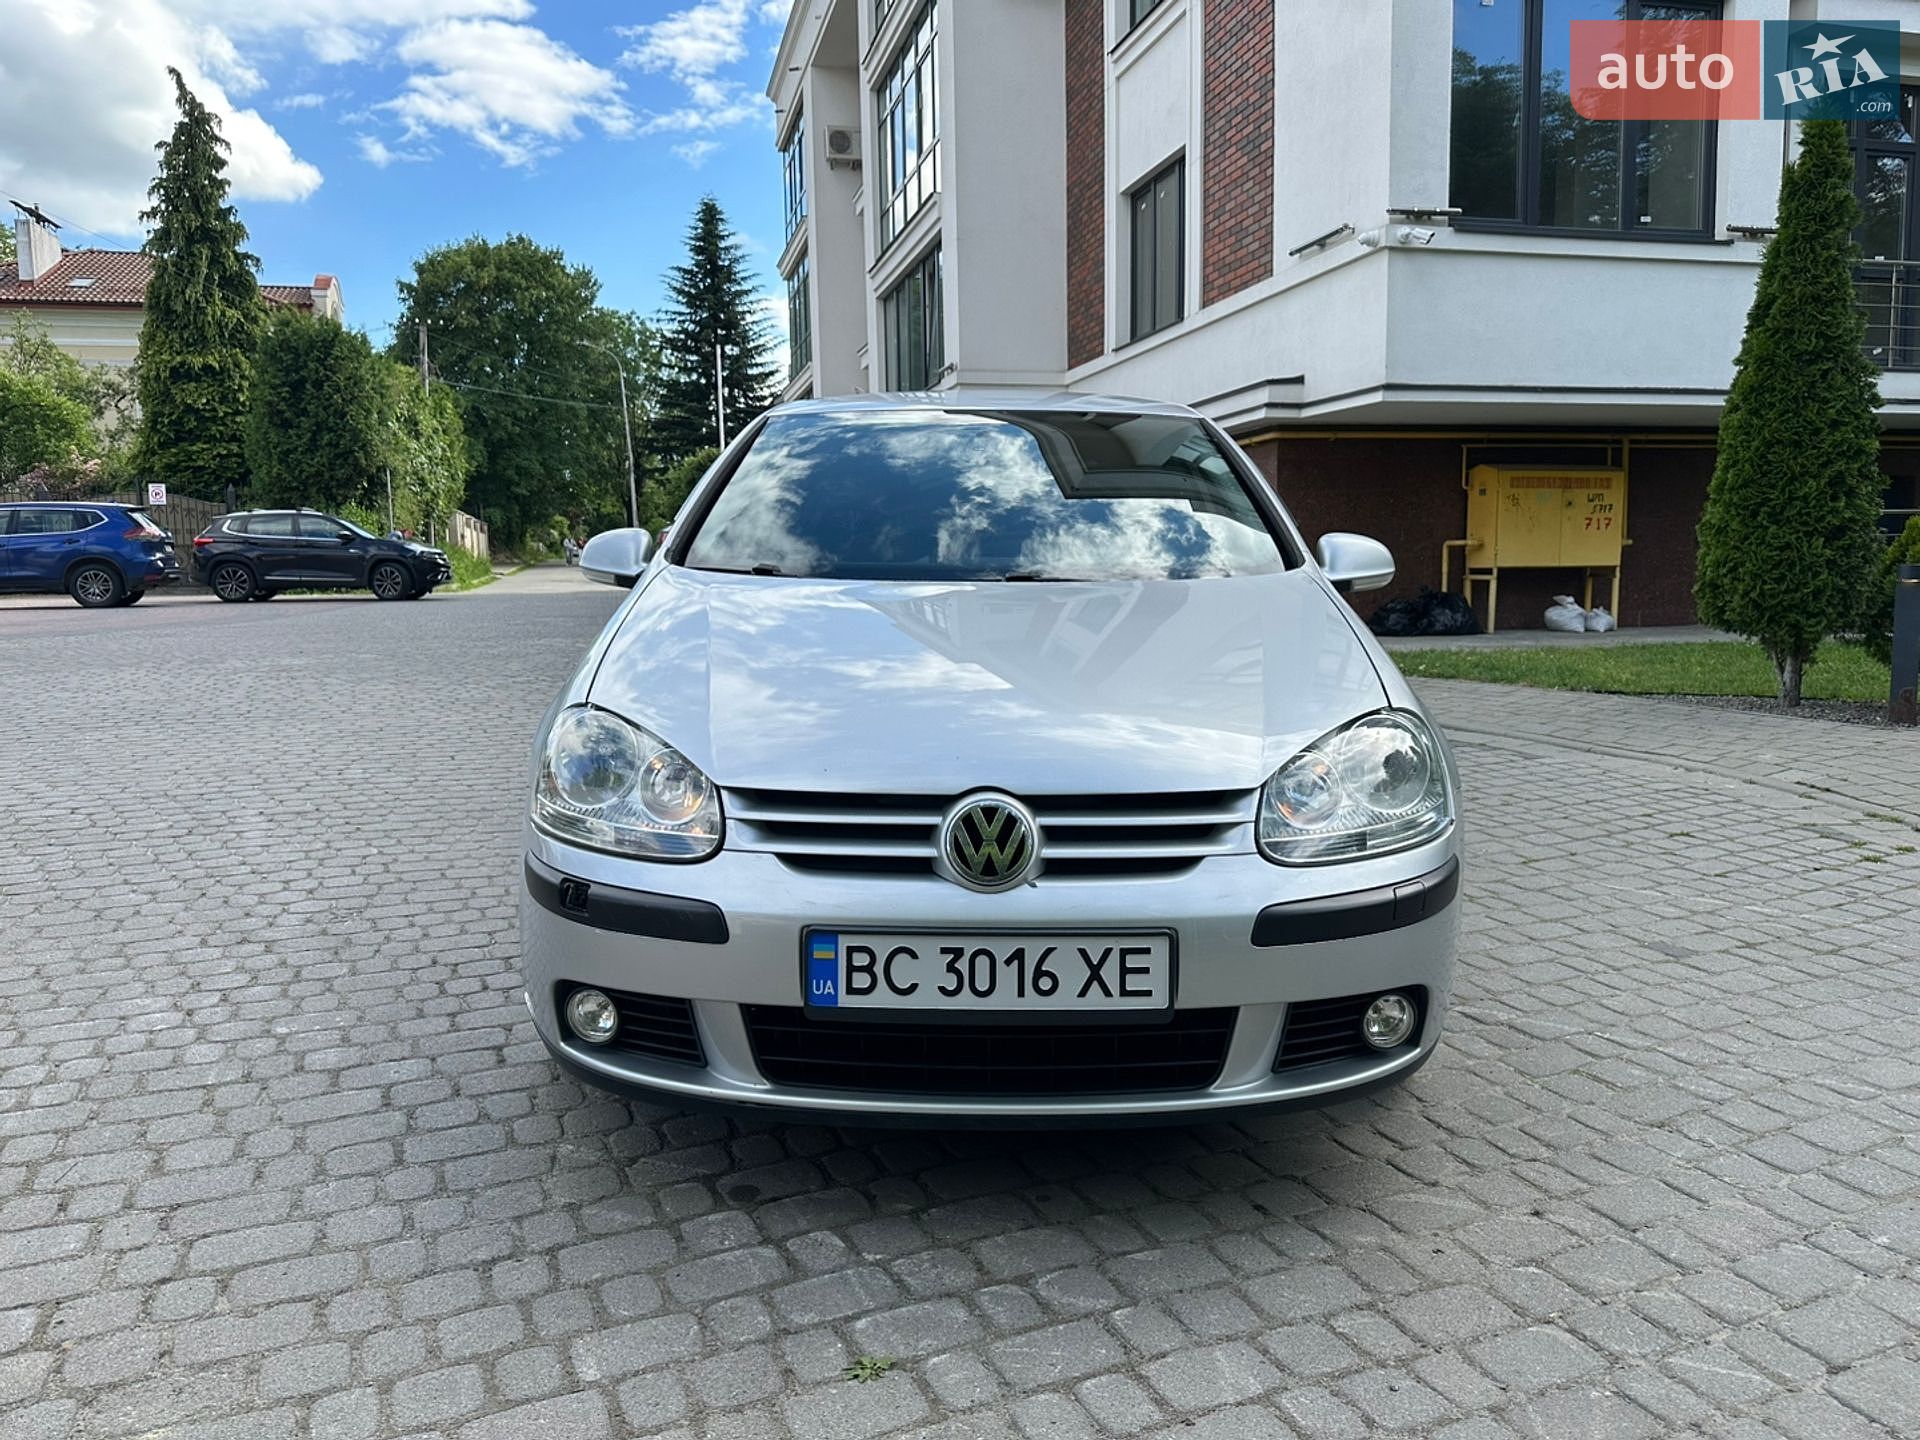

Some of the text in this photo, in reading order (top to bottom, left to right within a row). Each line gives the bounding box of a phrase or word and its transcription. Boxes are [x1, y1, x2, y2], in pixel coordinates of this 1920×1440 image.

[813, 979, 835, 996] UA
[845, 945, 1154, 999] BC 3016 XE
